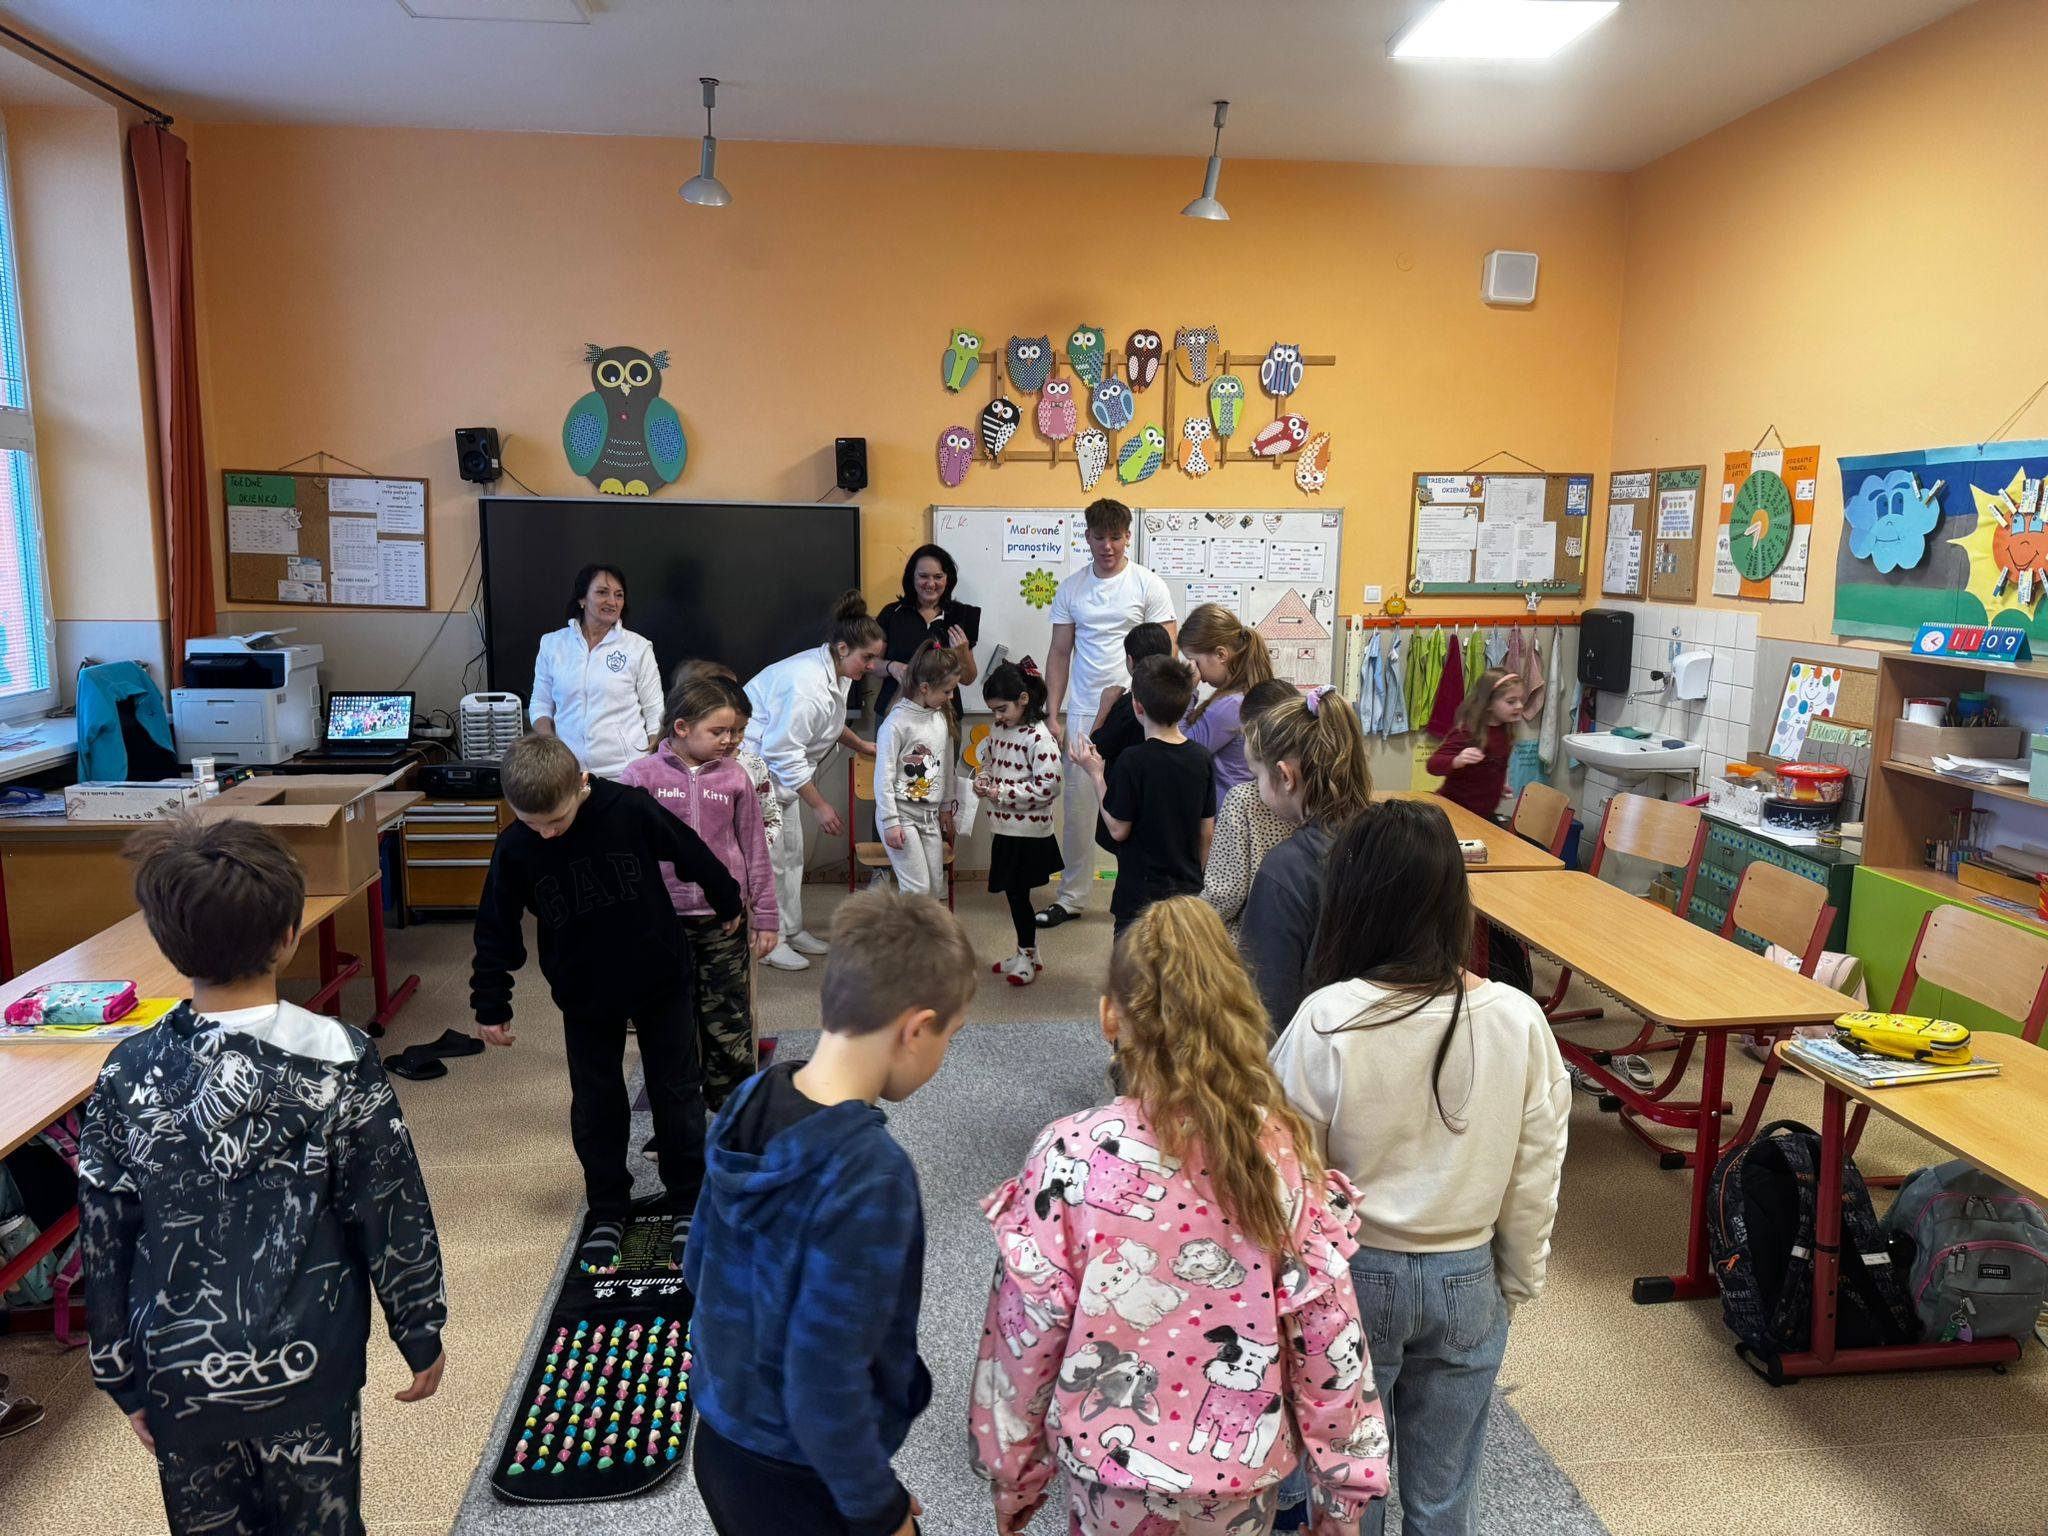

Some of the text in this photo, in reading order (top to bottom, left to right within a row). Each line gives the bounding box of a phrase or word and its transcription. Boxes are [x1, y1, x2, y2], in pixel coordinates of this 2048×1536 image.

[1010, 525, 1060, 536] Maľované
[1008, 542, 1061, 554] pranostiky
[657, 787, 729, 805] Hello Kitty
[535, 851, 642, 930] GAP
